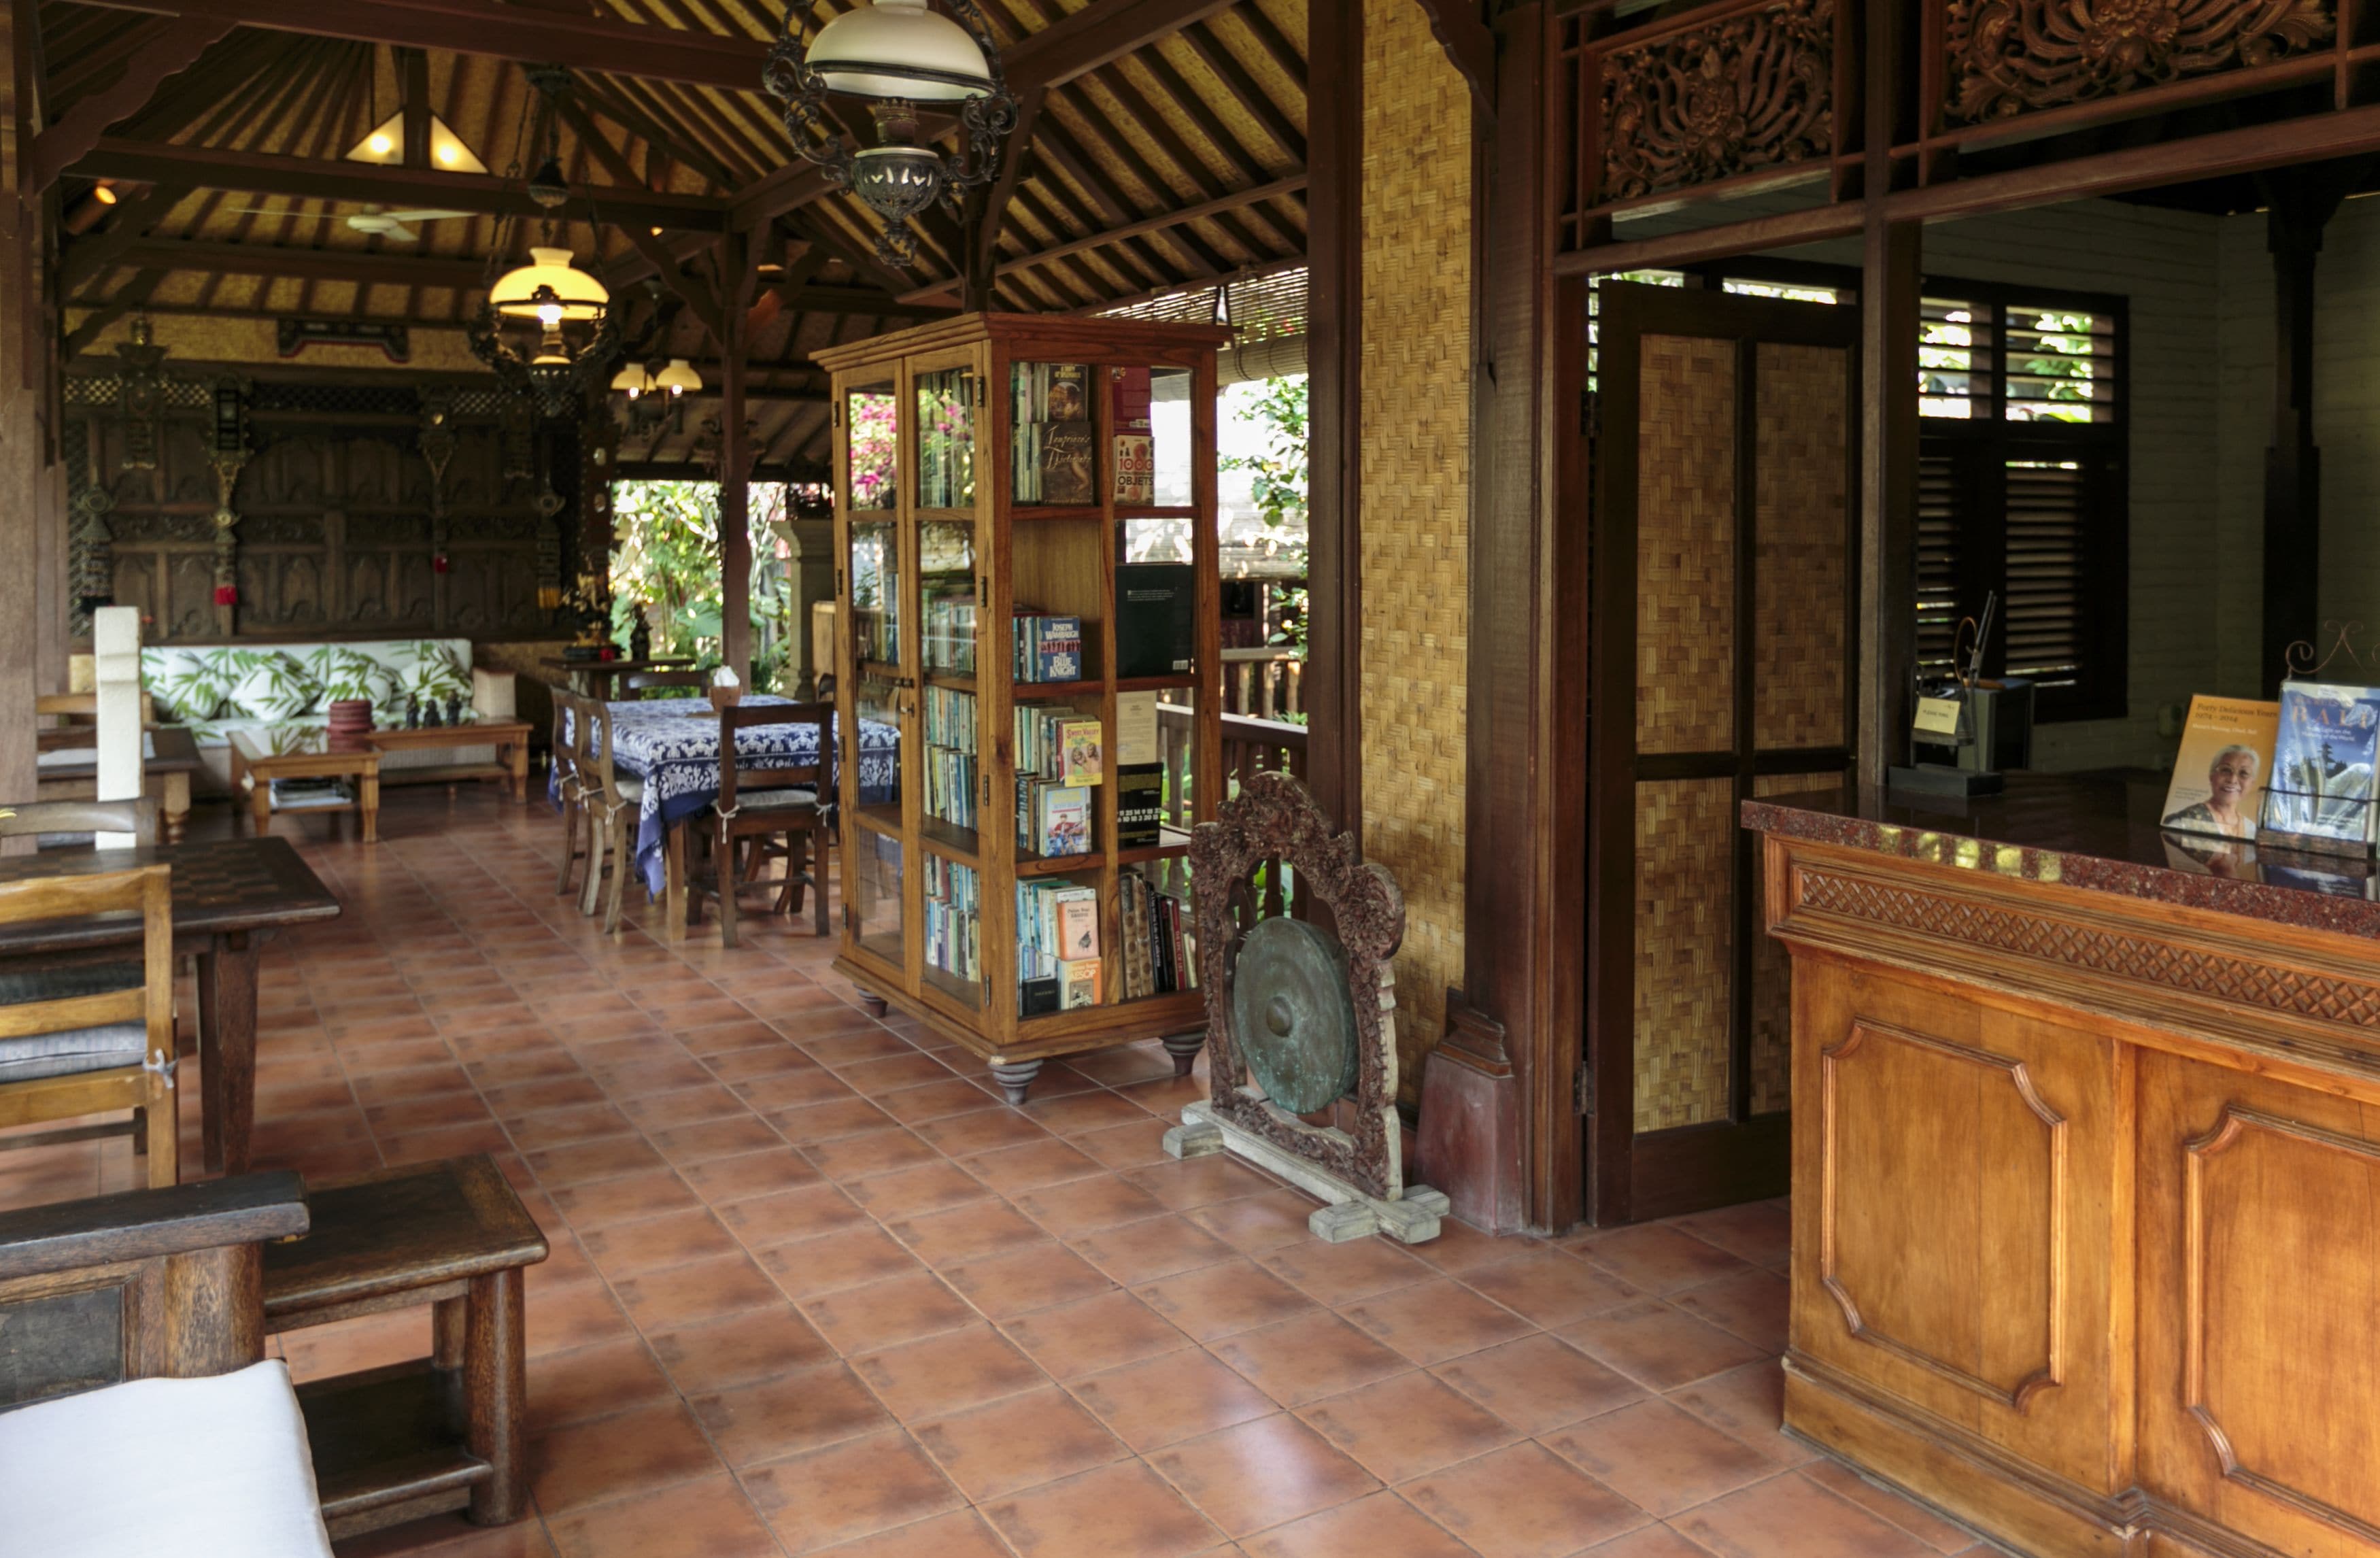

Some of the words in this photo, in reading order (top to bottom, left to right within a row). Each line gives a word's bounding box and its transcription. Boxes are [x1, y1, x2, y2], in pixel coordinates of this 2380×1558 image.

[1119, 458, 1154, 471] 1000
[1117, 476, 1154, 486] OBJETS
[1052, 623, 1073, 632] JOSEPH
[1045, 630, 1078, 640] WAMBAUGH
[1053, 656, 1072, 667] BLUE
[1049, 666, 1076, 677] KNIGHT
[1072, 968, 1096, 980] AESOP
